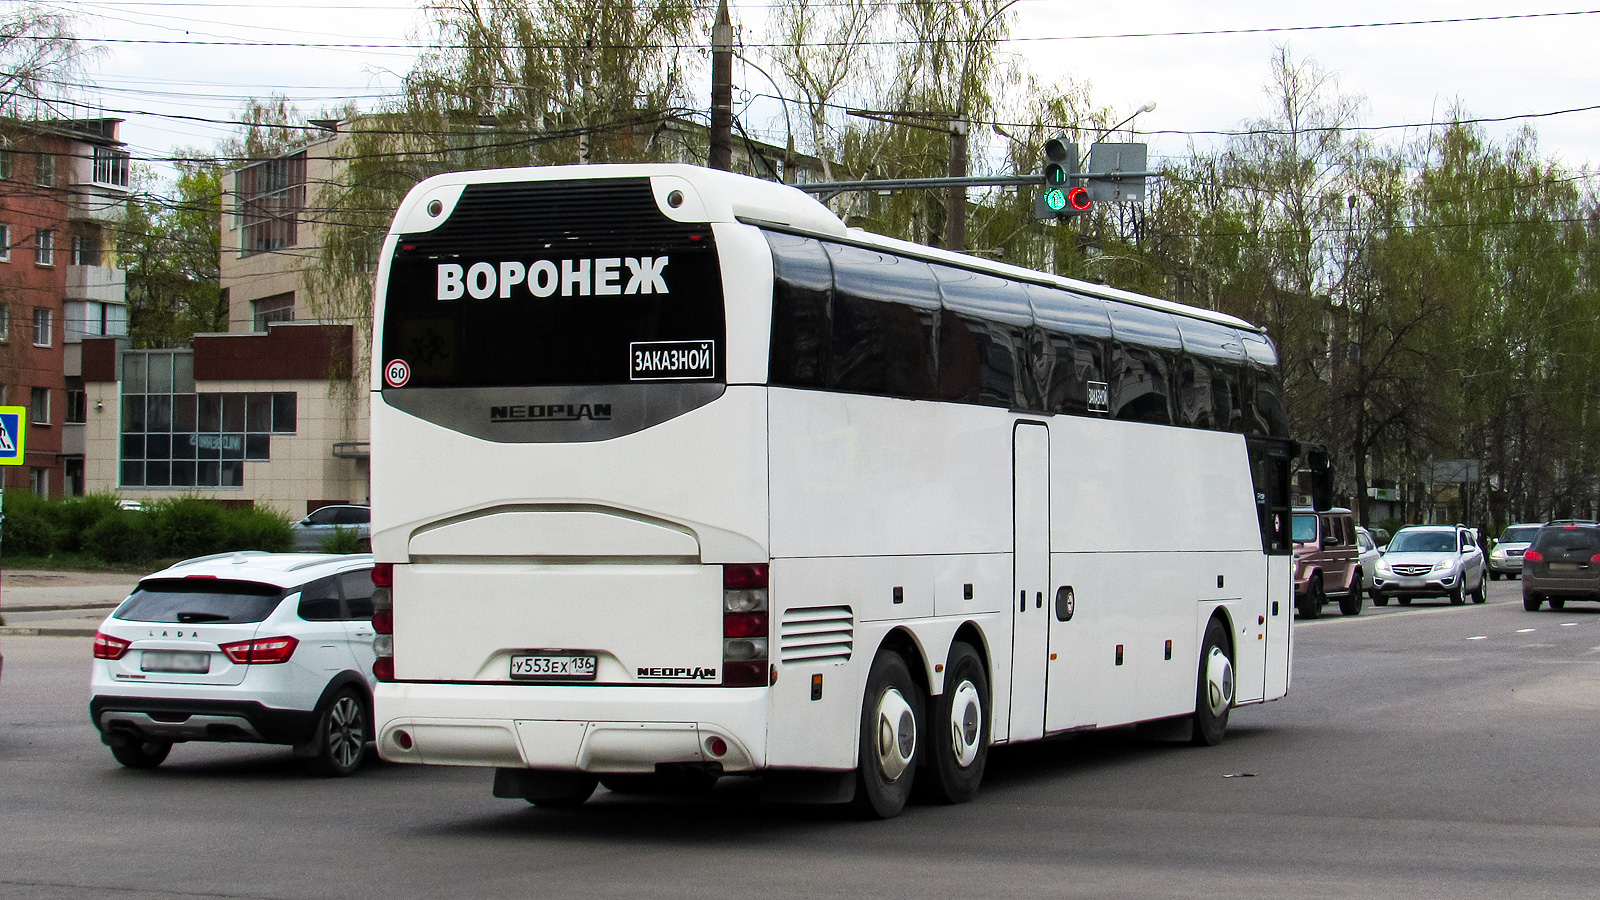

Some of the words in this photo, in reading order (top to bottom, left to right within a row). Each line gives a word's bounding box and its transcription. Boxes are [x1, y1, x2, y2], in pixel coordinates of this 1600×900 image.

[437, 256, 669, 300] ВОРОНЕЖ
[635, 343, 710, 371] ЗАКАЗНОЙ
[391, 367, 405, 379] 60
[491, 404, 611, 422] NEOPLAN
[149, 630, 198, 638] LADA
[571, 657, 591, 669] 136
[637, 667, 716, 680] NEOPLAN
